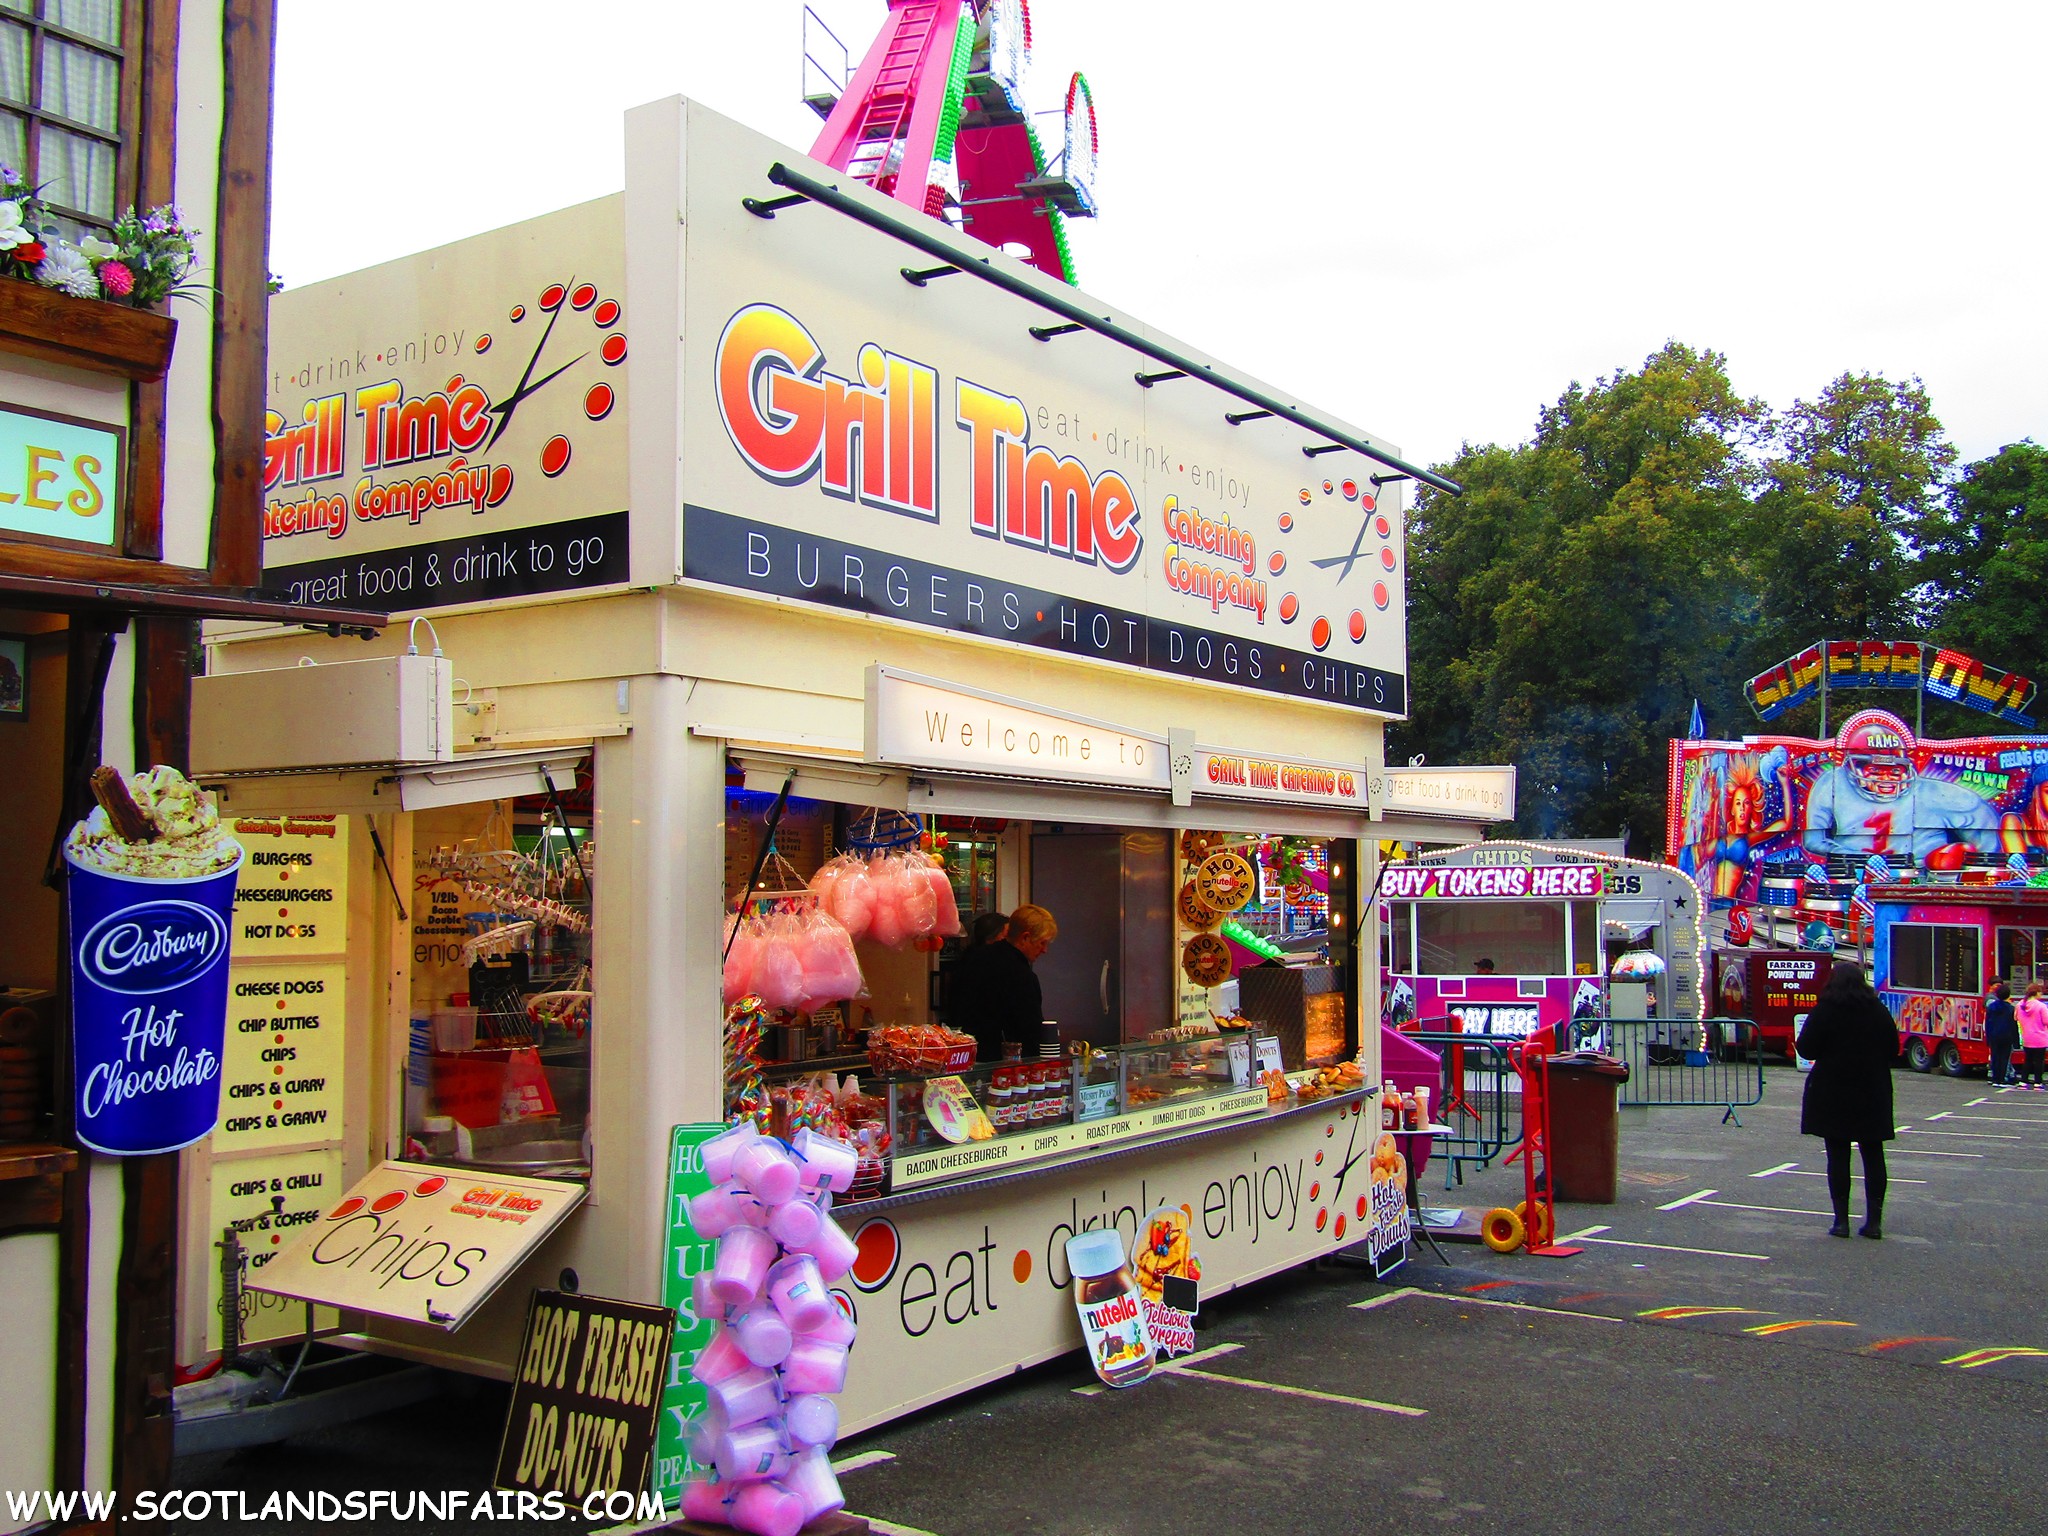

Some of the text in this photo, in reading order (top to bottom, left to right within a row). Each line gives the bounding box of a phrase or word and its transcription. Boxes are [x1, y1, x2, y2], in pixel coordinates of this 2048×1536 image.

[299, 350, 367, 388] drink
[386, 329, 465, 364] enjoy
[355, 378, 493, 471] Time
[714, 302, 1144, 574] Grill Time
[1037, 405, 1251, 507] eat drink enjoy
[352, 464, 490, 524] Company
[1163, 494, 1256, 575] Catering
[291, 536, 604, 605] great food & drink to go
[1163, 542, 1267, 624] Company
[747, 532, 1384, 703] BURGERS HOT DOGS CHIPS
[925, 710, 1145, 766] Welcome to
[1866, 734, 1899, 748] RAMS
[1933, 753, 1987, 771] TOUCH
[2000, 750, 2032, 770] FEELING
[1207, 756, 1356, 798] GRILL TIME CATERING CO.
[1962, 769, 2010, 790] DOWN
[1388, 778, 1503, 808] great food & drink to go
[234, 820, 336, 838] Catering Company
[1862, 811, 1896, 854] 1
[252, 852, 312, 866] BURGERS
[1206, 858, 1248, 877] HOT
[1420, 857, 1447, 866] RINKS
[1471, 850, 1533, 865] CHIPS
[1555, 854, 1579, 863] COLD
[235, 888, 333, 902] HEESEBURGERS
[1202, 879, 1249, 906] DONUTS
[1211, 877, 1240, 887] nutella
[1381, 867, 1596, 897] BUY TOKENS HERE
[431, 891, 459, 904] 1/2lb
[431, 905, 458, 915] Bacon
[245, 924, 316, 939] HOT DOGS
[414, 926, 471, 936] Cheeseburge
[427, 916, 462, 925] Double
[95, 923, 208, 976] Cadbury
[1189, 938, 1224, 957] HOT
[1188, 958, 1228, 981] DONUTS
[1767, 970, 1815, 979] POWER UNIT
[1769, 961, 1813, 969] FARRAR'S
[235, 980, 324, 997] CHEESE DOGS
[1767, 993, 1818, 1007] FUN FAIR
[121, 1004, 183, 1063] Hot
[238, 1015, 319, 1032] CHIP BUTTIES
[1490, 1007, 1538, 1036] HERE
[261, 1047, 296, 1062] CHIPS
[1234, 1050, 1239, 1061] 4
[82, 1046, 220, 1119] Chocolate
[229, 1078, 325, 1099] CHIPS & CURRY
[226, 1110, 327, 1132] CHIPS & GRAVY
[906, 1094, 1264, 1176] BACON CHEESEBURGER CHIPS ROAST PORK JUMBO HOT DOGS CHEESEBURGER
[231, 1173, 322, 1196] CHIPS & CHILLI
[1371, 1177, 1394, 1213] Hot
[462, 1186, 543, 1213] Grill Time
[1378, 1189, 1405, 1230] Fresh
[259, 1217, 270, 1230] &
[275, 1210, 319, 1228] COFFEE
[901, 1225, 997, 1337] eat
[1203, 1151, 1303, 1244] enjoy
[1368, 1212, 1410, 1259] Donuts
[312, 1214, 487, 1290] Chips
[1087, 1296, 1138, 1329] nutella
[1141, 1299, 1190, 1330] Delicious
[523, 1305, 663, 1408] HOT FRESH
[515, 1402, 629, 1502] DO-NUTS
[659, 1454, 708, 1489] PEA
